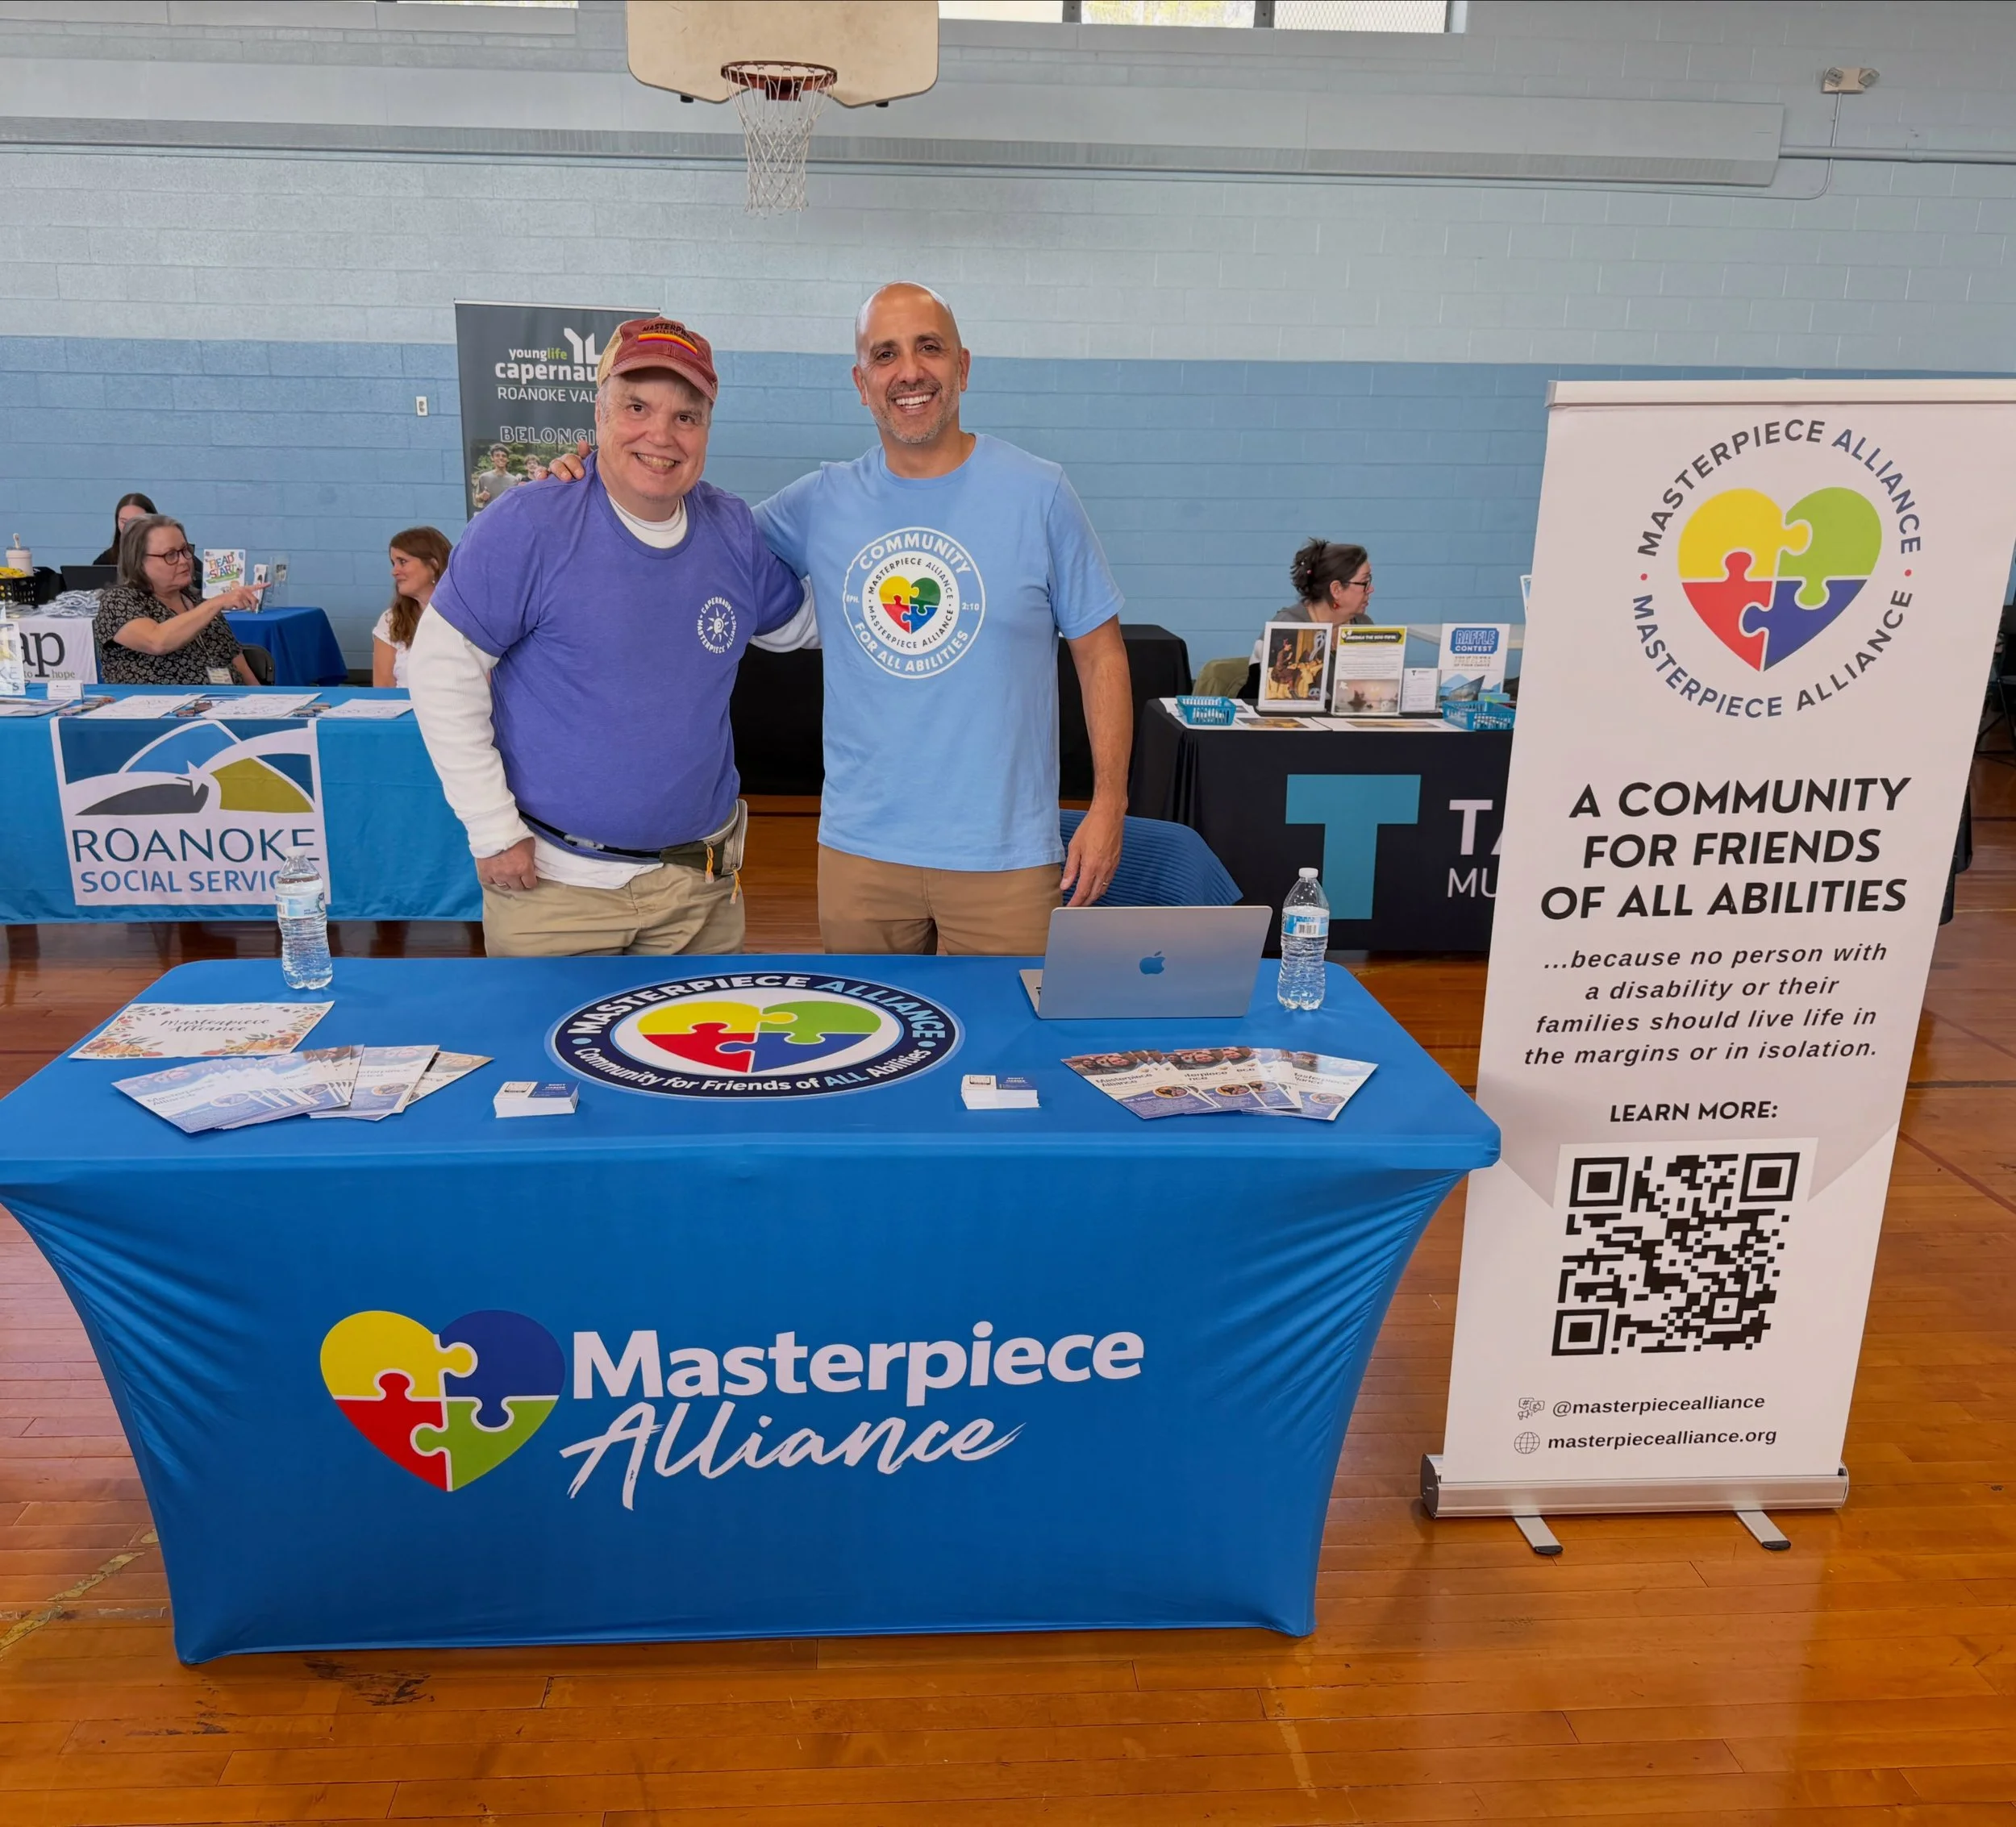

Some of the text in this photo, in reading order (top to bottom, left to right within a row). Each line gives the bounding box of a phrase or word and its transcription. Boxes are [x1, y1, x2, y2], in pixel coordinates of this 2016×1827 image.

[509, 348, 567, 361] younglife
[495, 362, 598, 385] capernau
[498, 387, 597, 403] ROANOKE VAL
[500, 426, 595, 446] BELONGI
[1637, 419, 1921, 556] MASTERPIECE ALLIANCE
[860, 533, 971, 574] COMMUNITY
[868, 557, 953, 599] MASTERPIECE ALLIANCE
[701, 597, 731, 614] CAPERNAUM
[961, 602, 980, 610] 2:10
[697, 615, 737, 654] MASTERPIECE ALLIANCE
[868, 606, 953, 649] MASTERPIECE ALLIANCE
[1456, 630, 1495, 645] RAFFLE
[855, 622, 968, 672] FOR ALL ABILITIES
[1633, 590, 1913, 718] MASTERPIECE ALLIANCE
[52, 669, 75, 680] hope
[1569, 777, 1911, 818] A COMMUNITY
[1449, 800, 1504, 855] T
[73, 828, 319, 863] ROANOKE
[1584, 829, 1881, 868] FOR FRIENDS
[81, 869, 277, 893] SOCIAL SERVIC
[1447, 868, 1497, 897] MU
[1541, 879, 1907, 920] OF ALL ABILITIES
[1544, 943, 1886, 968] ...because no person with
[1585, 976, 1839, 1001] a disability or their
[568, 975, 945, 1038] MASTERPIECE ALLIANCE
[1536, 1008, 1876, 1033] families should live life in
[1525, 1040, 1875, 1066] the margins or in isolation.
[573, 1048, 932, 1091] Community for Friends of ALL Abilities
[1610, 1101, 1777, 1122] LEARN MORE:
[573, 1321, 1143, 1407] Masterpiece
[1553, 1396, 1764, 1417] @masterpiecealliance
[1548, 1430, 1776, 1450] masterpiecealliance.org
[560, 1400, 1027, 1510] Alliance
